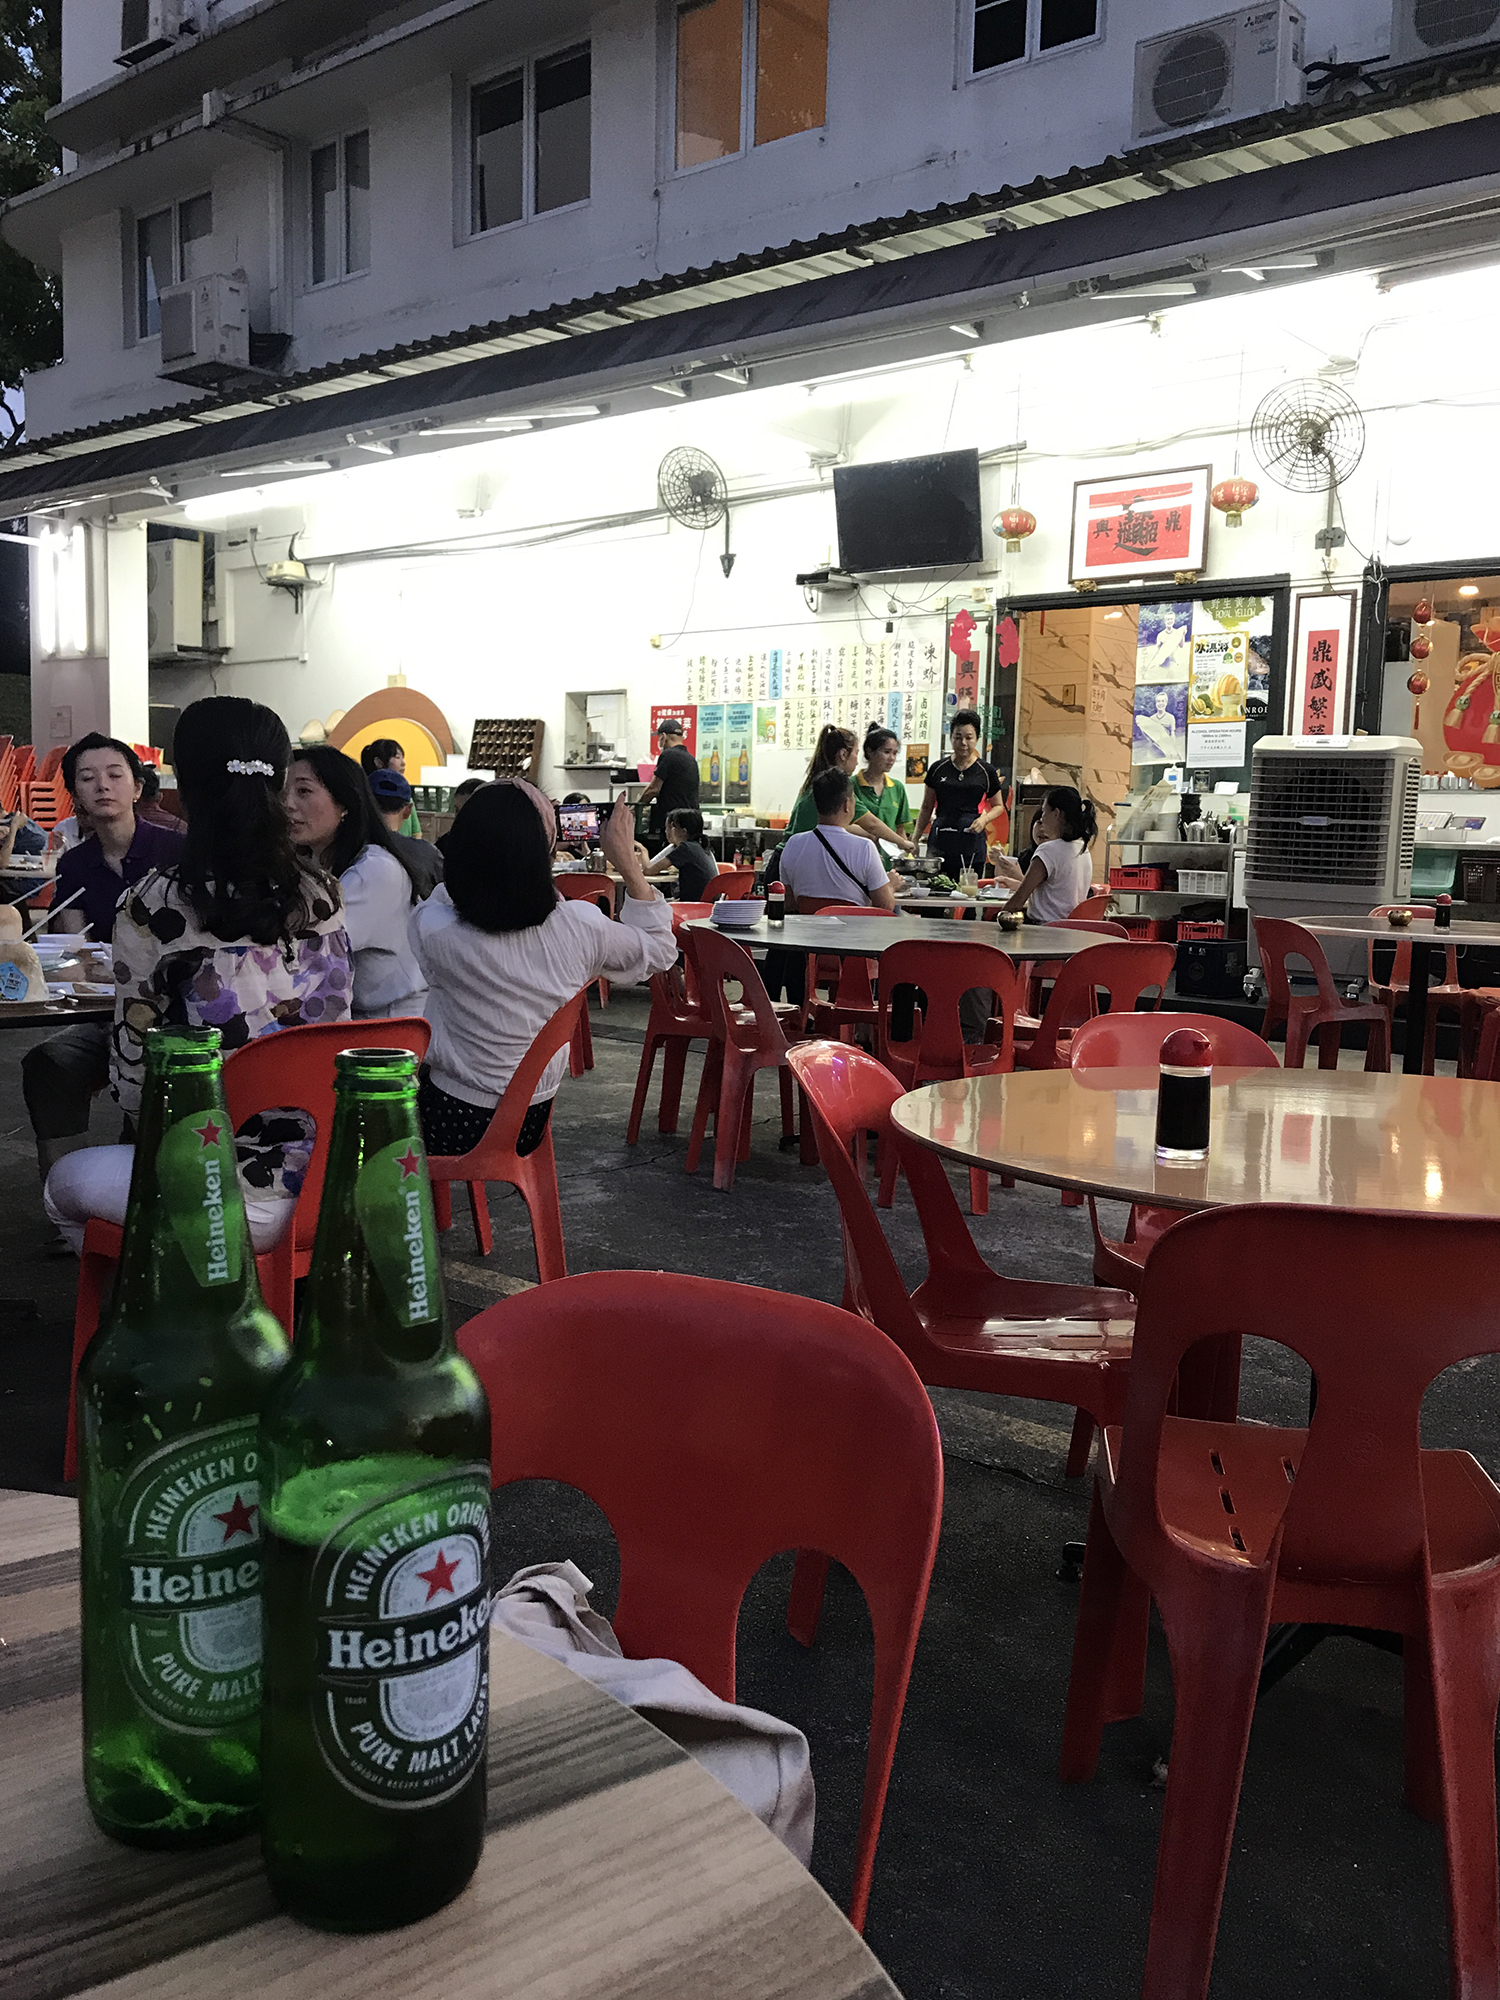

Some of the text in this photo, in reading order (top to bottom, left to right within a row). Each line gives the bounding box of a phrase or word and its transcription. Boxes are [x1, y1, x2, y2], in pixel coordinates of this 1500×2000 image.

[202, 1158, 229, 1281] Heineken
[404, 1190, 430, 1320] Heineken
[144, 1456, 236, 1540] HEINEKEN
[345, 1509, 439, 1602] HEINEKEN
[327, 1591, 491, 1670] Heineke
[152, 1652, 262, 1702] PURE MALT
[349, 1720, 405, 1772] PURE
[406, 1736, 460, 1774] MALT
